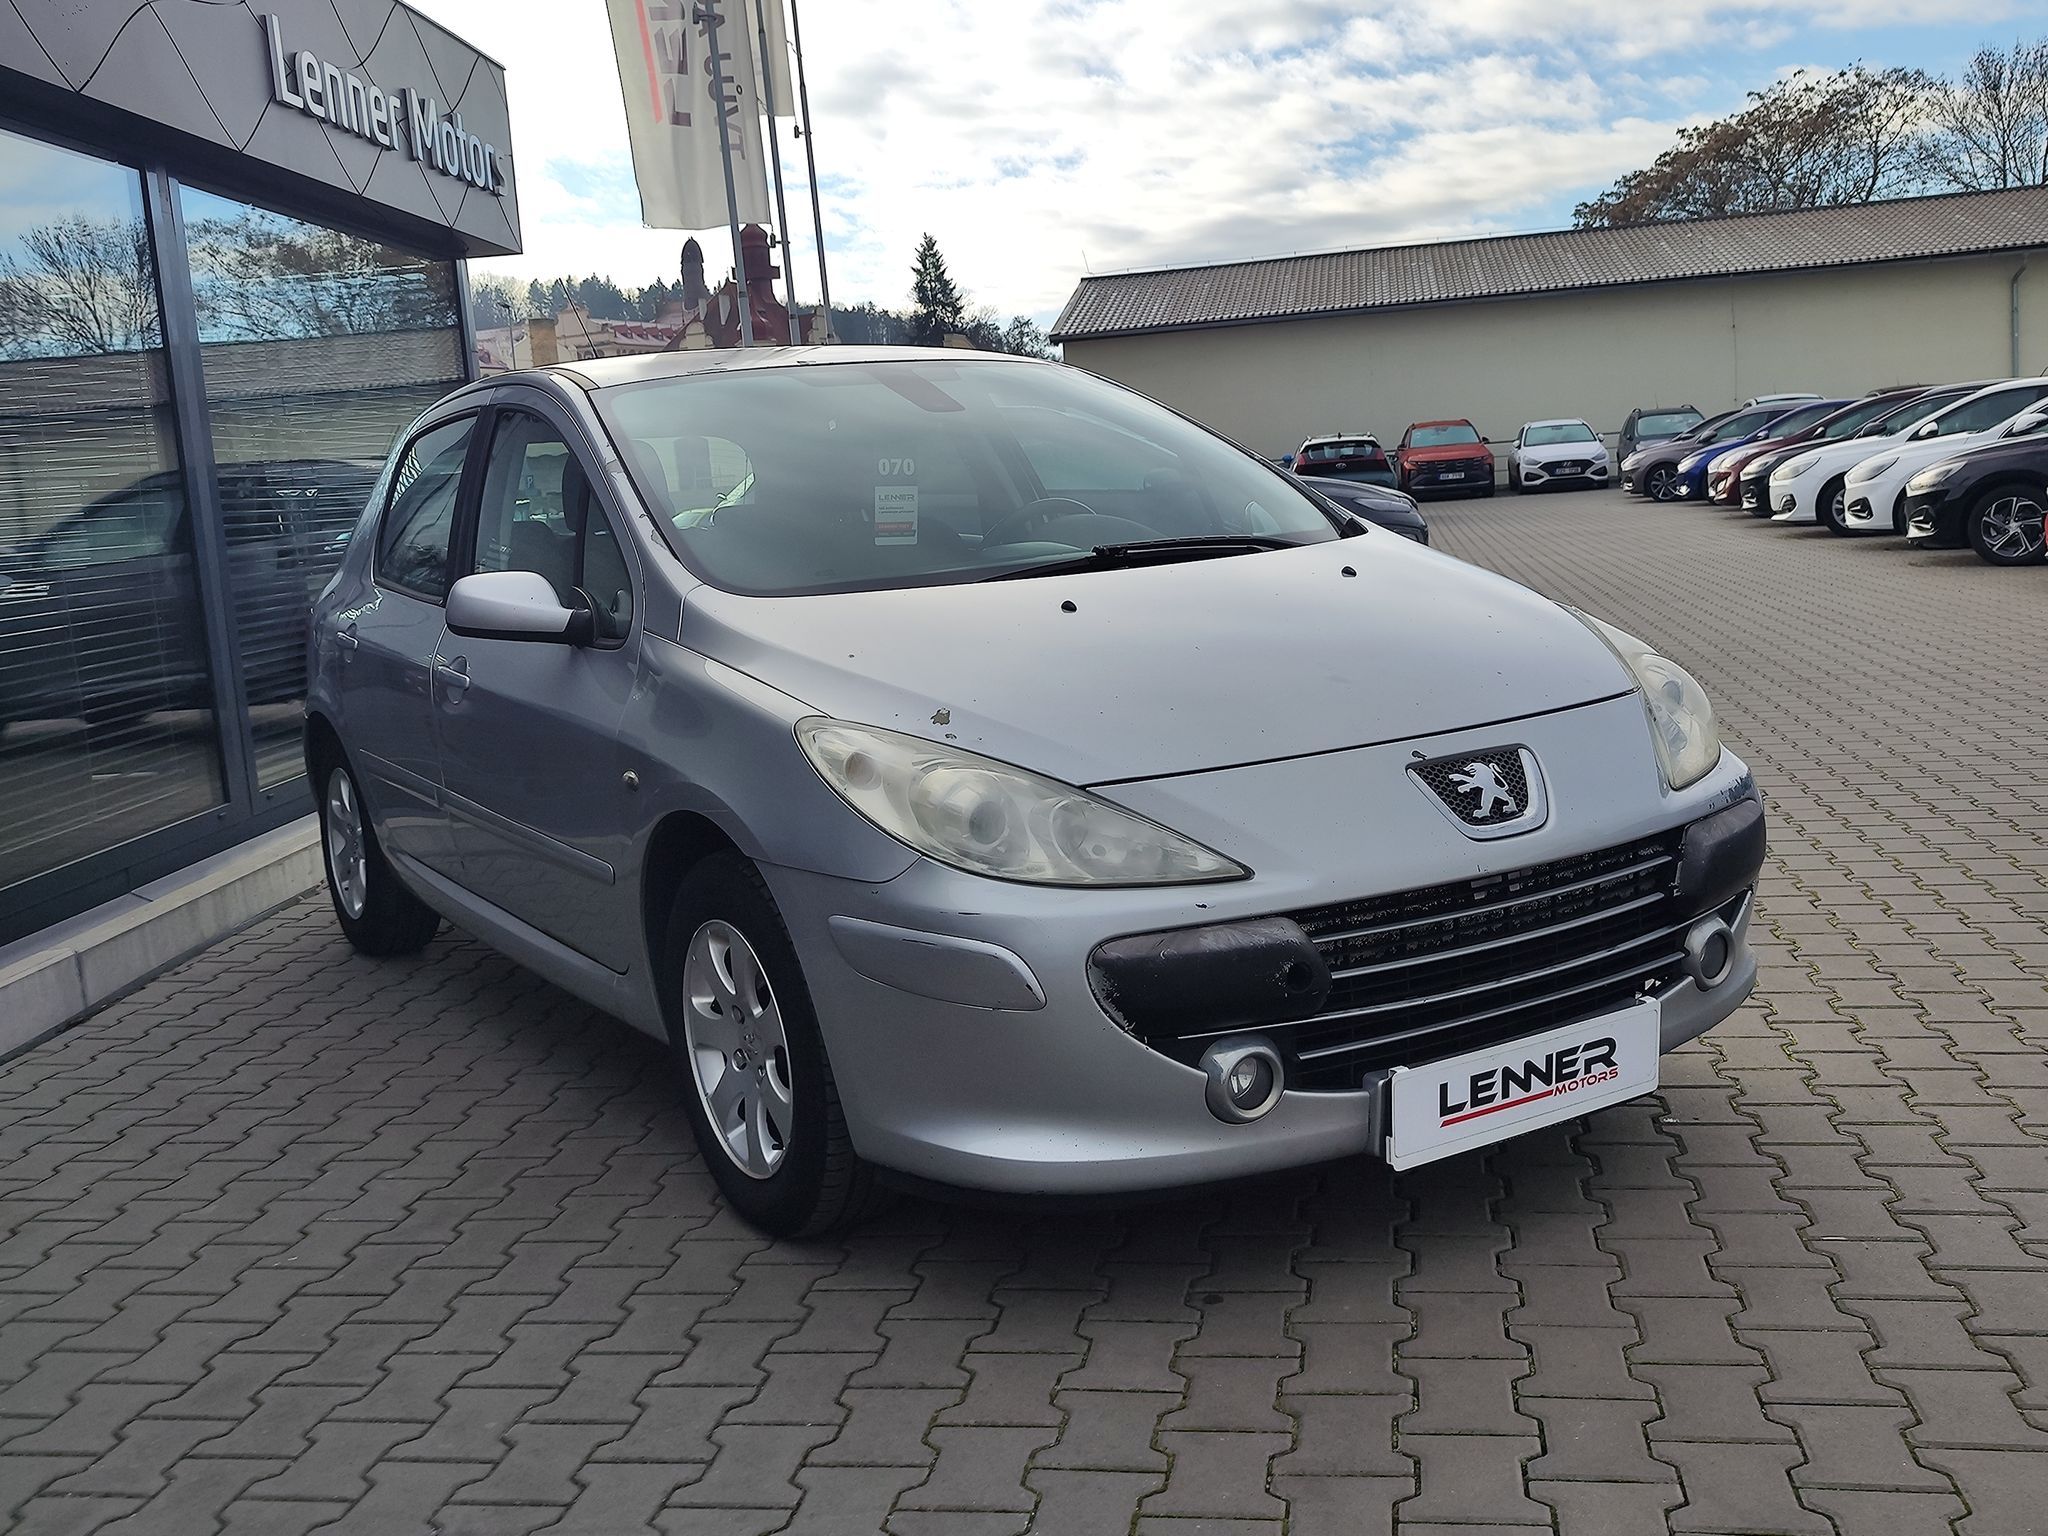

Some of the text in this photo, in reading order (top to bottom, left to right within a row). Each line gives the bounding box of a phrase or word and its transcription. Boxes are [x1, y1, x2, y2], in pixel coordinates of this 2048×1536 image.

[263, 13, 508, 196] Lenner Motors
[878, 458, 915, 475] 070
[1439, 1037, 1618, 1118] LENNER
[1553, 1067, 1619, 1097] MOTORS
